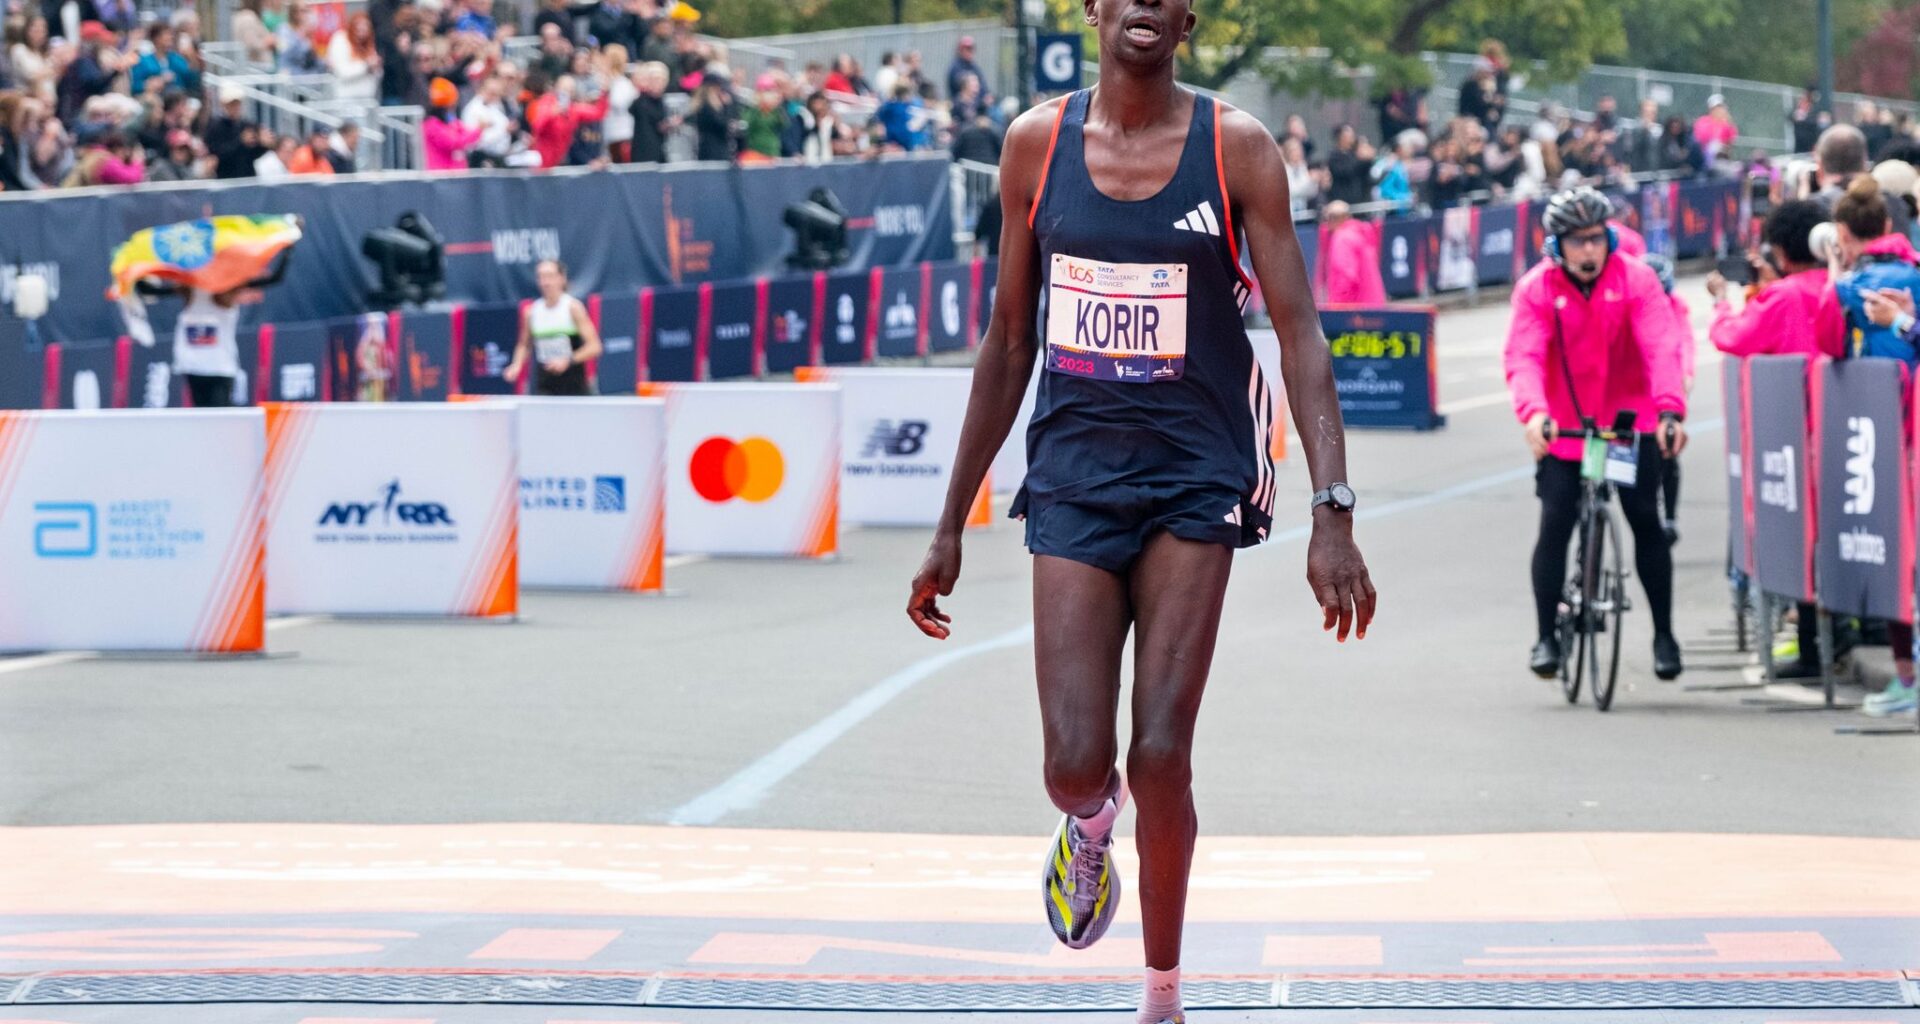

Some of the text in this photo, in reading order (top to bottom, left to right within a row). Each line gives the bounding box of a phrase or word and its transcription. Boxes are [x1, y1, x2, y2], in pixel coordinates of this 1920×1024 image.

[1042, 41, 1075, 82] G
[1068, 262, 1094, 284] tcs
[1097, 273, 1139, 281] CONSULTANCY
[1098, 266, 1115, 274] TATA
[1097, 280, 1124, 288] SERVICES
[1075, 298, 1160, 351] KORIR
[1057, 356, 1095, 374] 2023
[519, 477, 587, 491] NITED
[522, 496, 586, 509] LINES
[0, 927, 1843, 967] FINIS
